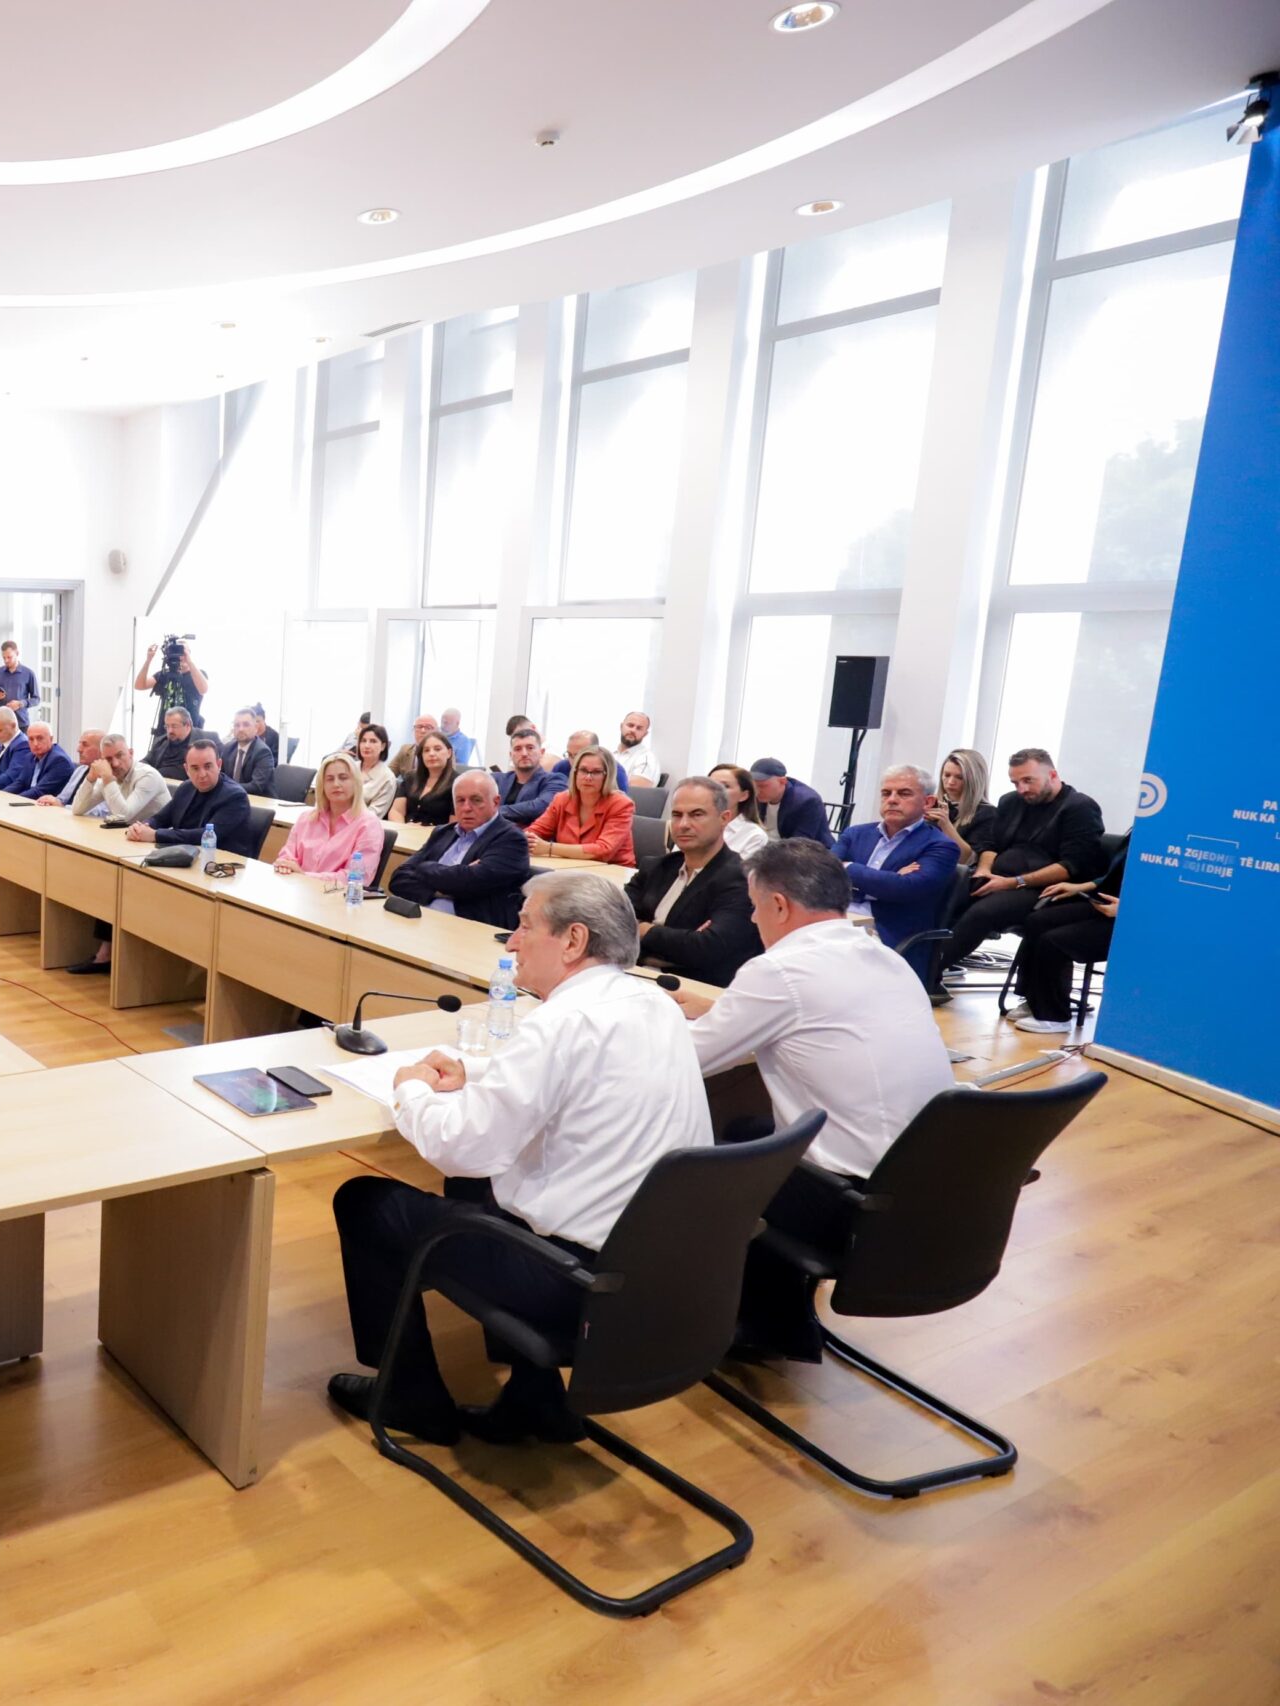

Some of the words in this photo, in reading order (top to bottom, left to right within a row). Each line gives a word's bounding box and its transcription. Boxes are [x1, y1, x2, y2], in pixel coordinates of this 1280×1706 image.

[1263, 800, 1278, 811] PA
[1232, 809, 1258, 821] NUK
[1258, 812, 1275, 824] KA
[1140, 853, 1163, 864] NUK
[1163, 856, 1179, 868] KA
[1167, 845, 1181, 856] PA
[1240, 857, 1254, 868] TË
[1254, 860, 1280, 873] LIRA
